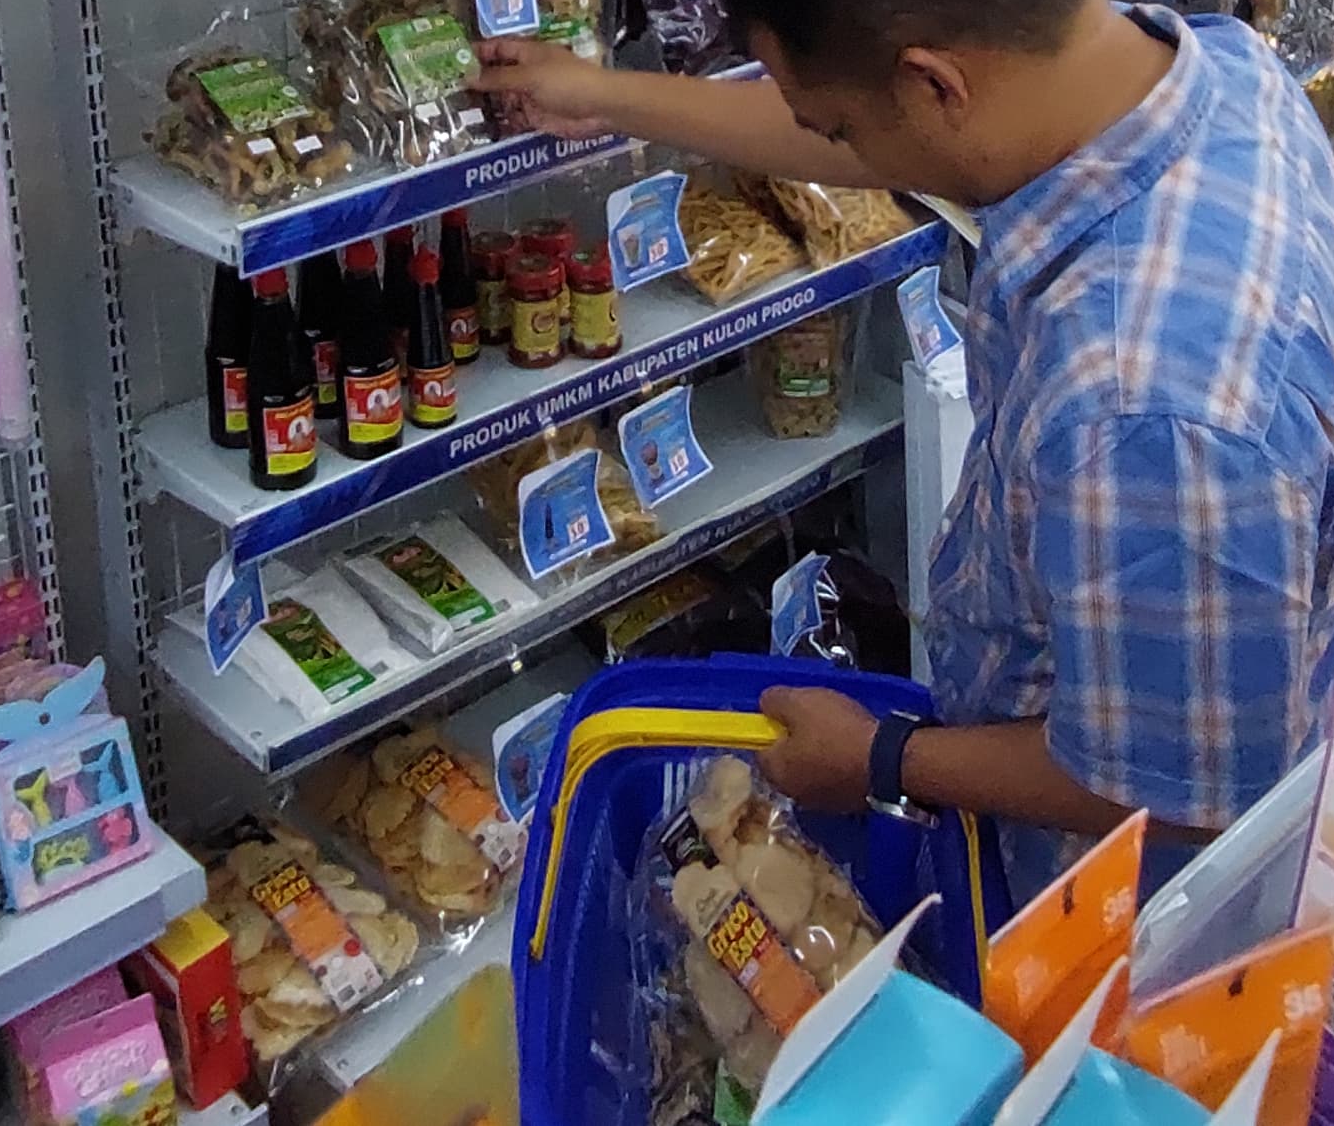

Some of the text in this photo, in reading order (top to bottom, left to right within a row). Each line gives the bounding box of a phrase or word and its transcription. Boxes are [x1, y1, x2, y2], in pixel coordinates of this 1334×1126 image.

[464, 144, 550, 189] PRODUK
[449, 287, 816, 459] PRODUK UMKM KABUPATEN KULON PROGO
